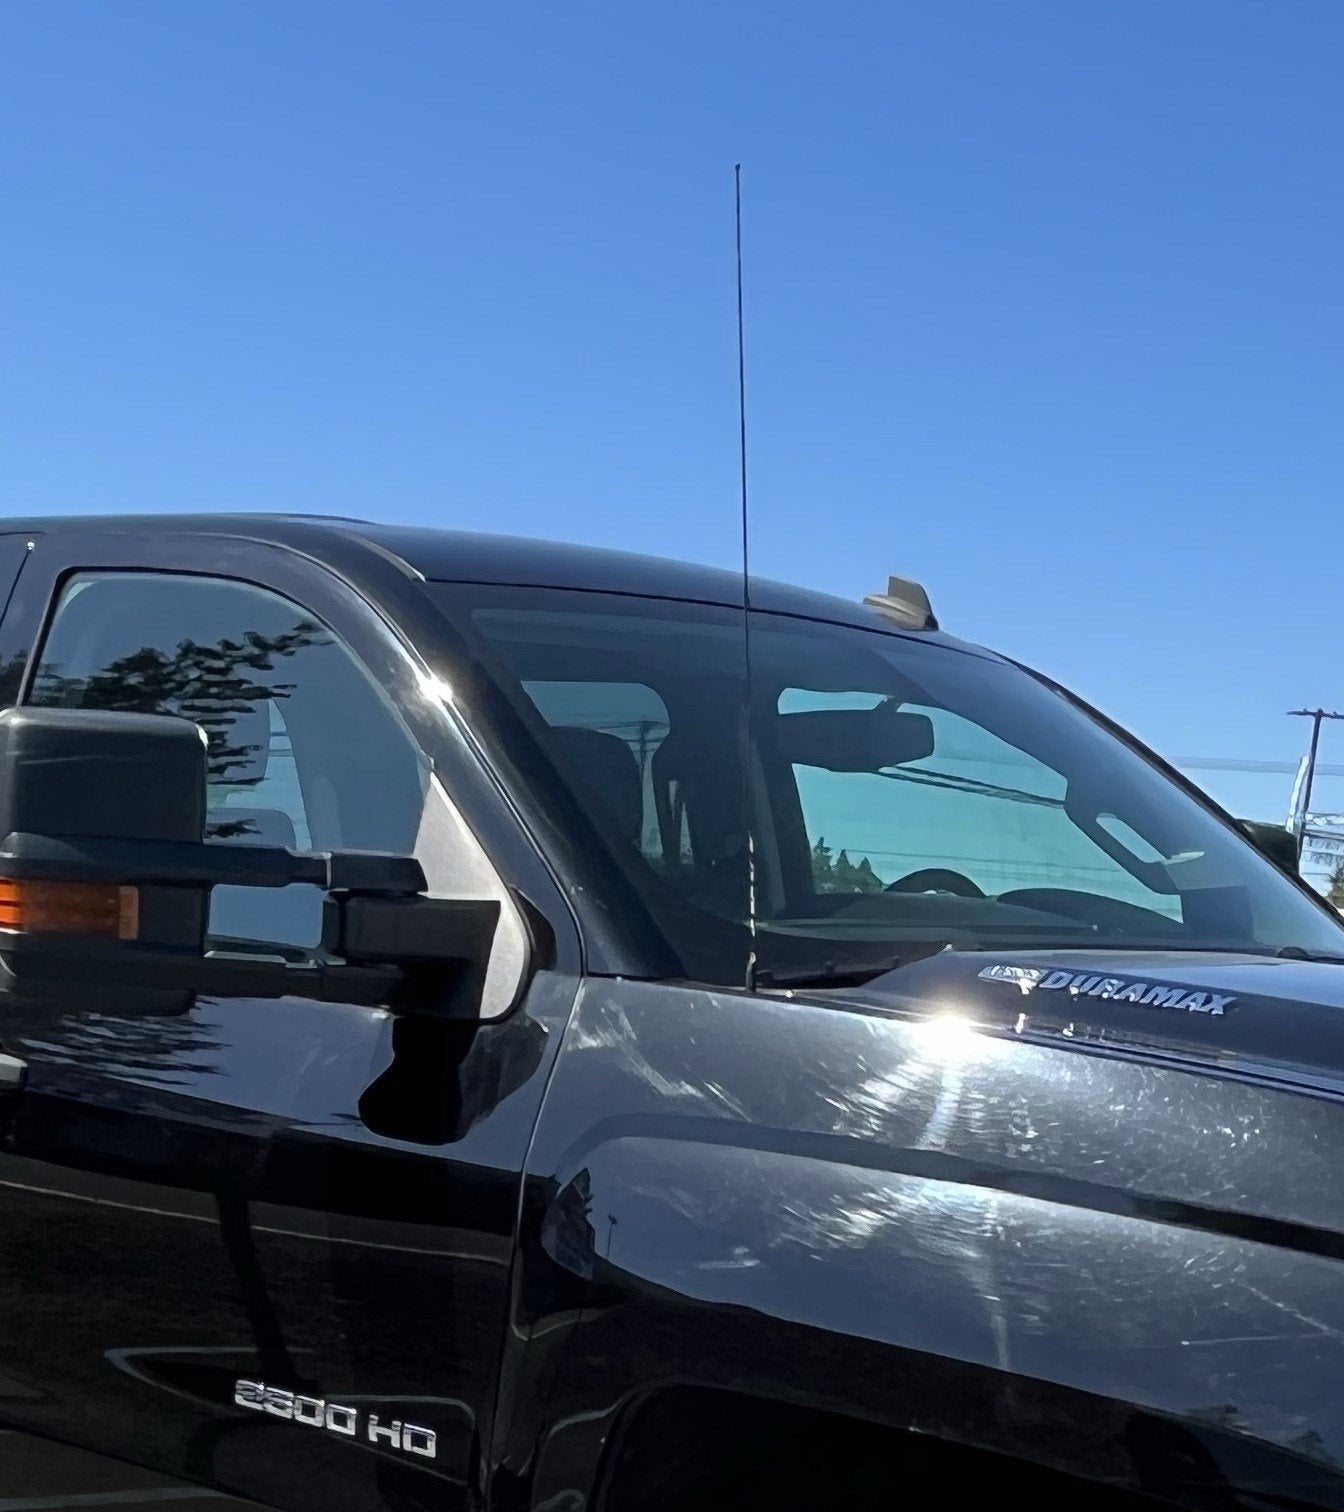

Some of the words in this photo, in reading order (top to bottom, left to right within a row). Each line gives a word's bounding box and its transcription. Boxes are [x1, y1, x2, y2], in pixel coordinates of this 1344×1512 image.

[1039, 971, 1237, 1016] DURAMAX
[234, 1379, 357, 1436] 2500
[367, 1413, 437, 1458] HD
